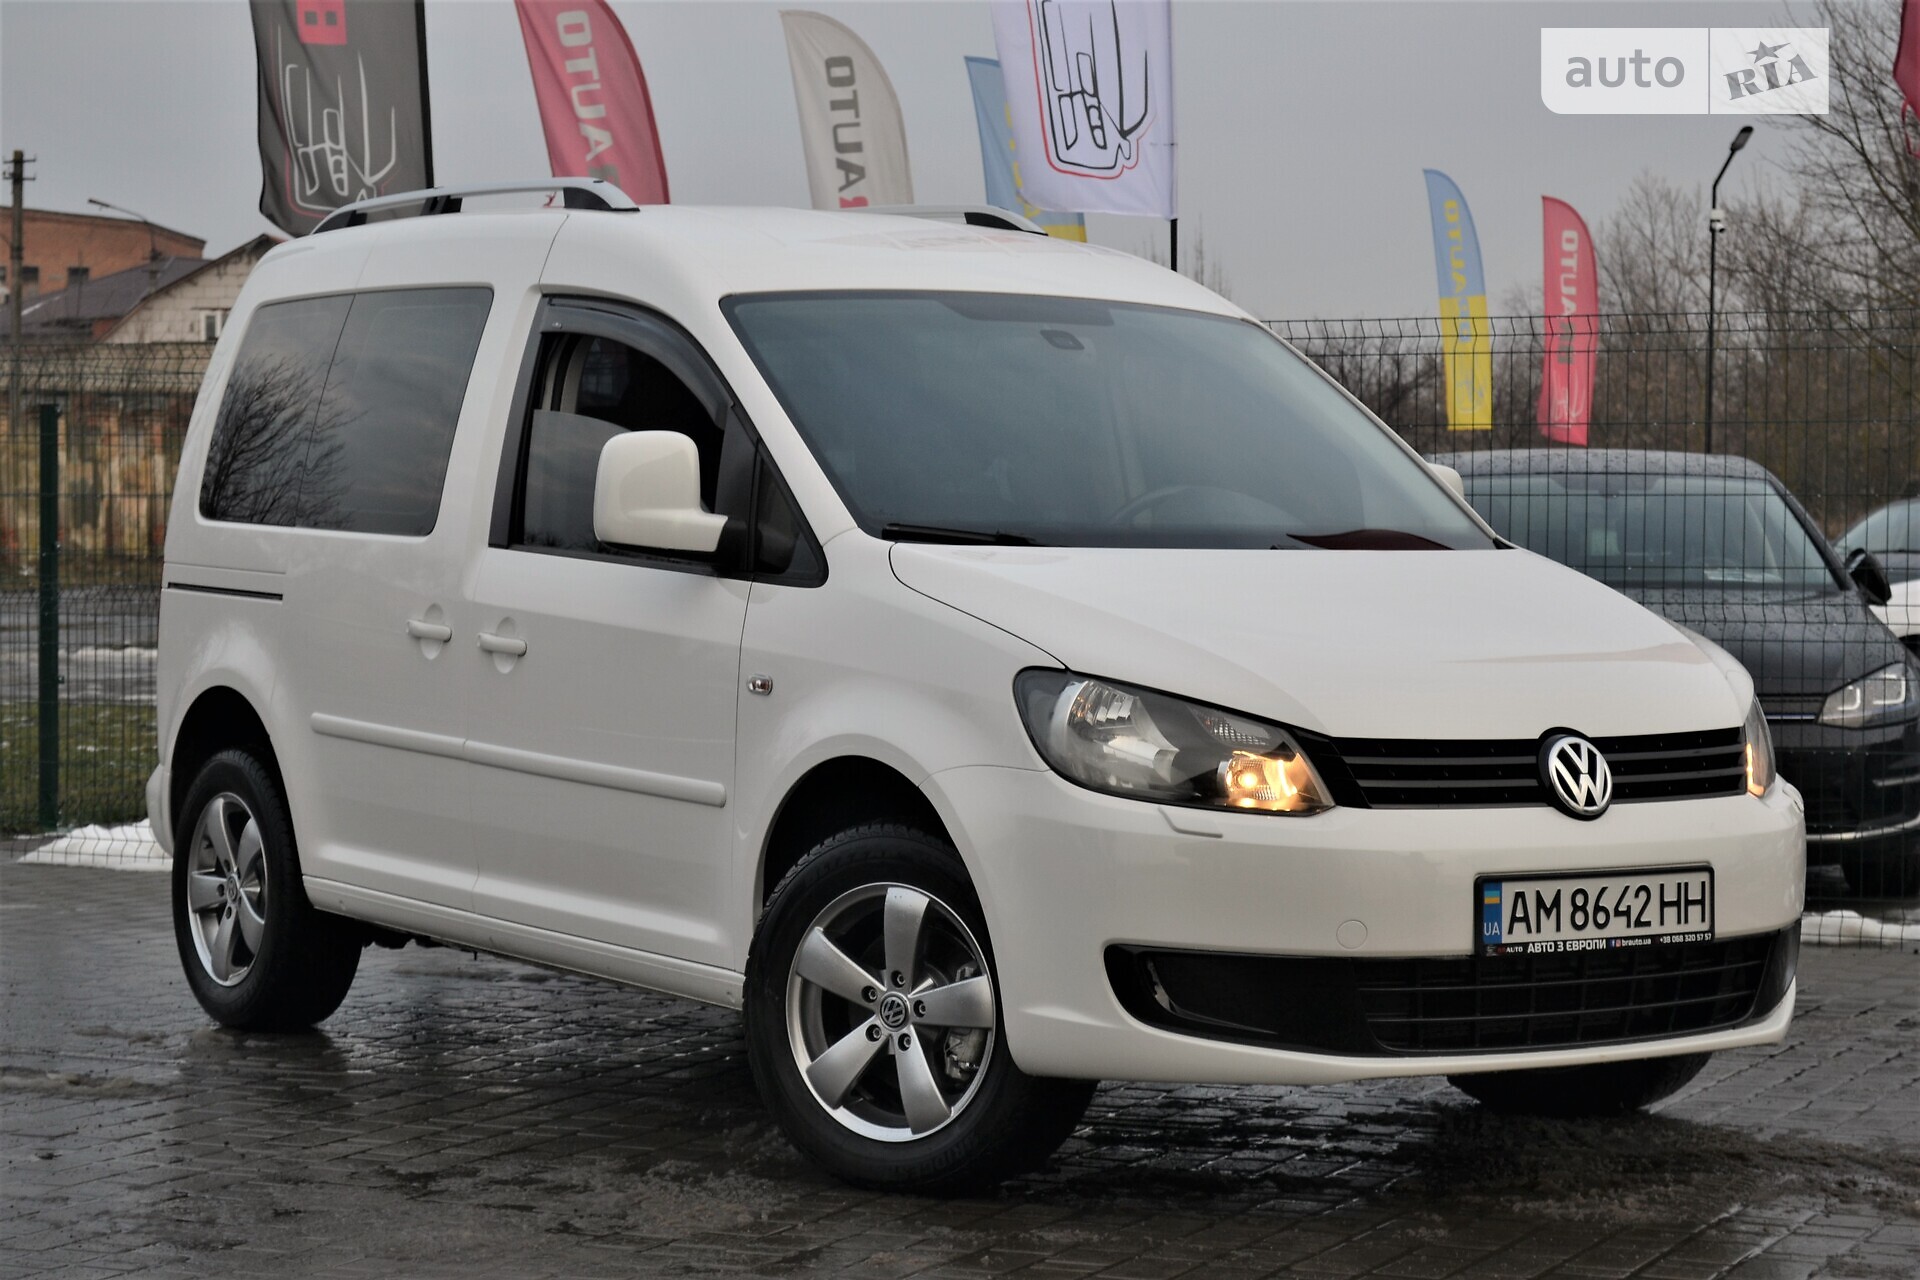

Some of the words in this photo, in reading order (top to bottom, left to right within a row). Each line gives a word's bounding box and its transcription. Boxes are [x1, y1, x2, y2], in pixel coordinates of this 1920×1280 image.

[1483, 922, 1501, 936] UA
[1527, 942, 1555, 954] АВТО
[1566, 939, 1607, 952] ЄВРОПИ
[1659, 936, 1671, 944] +38
